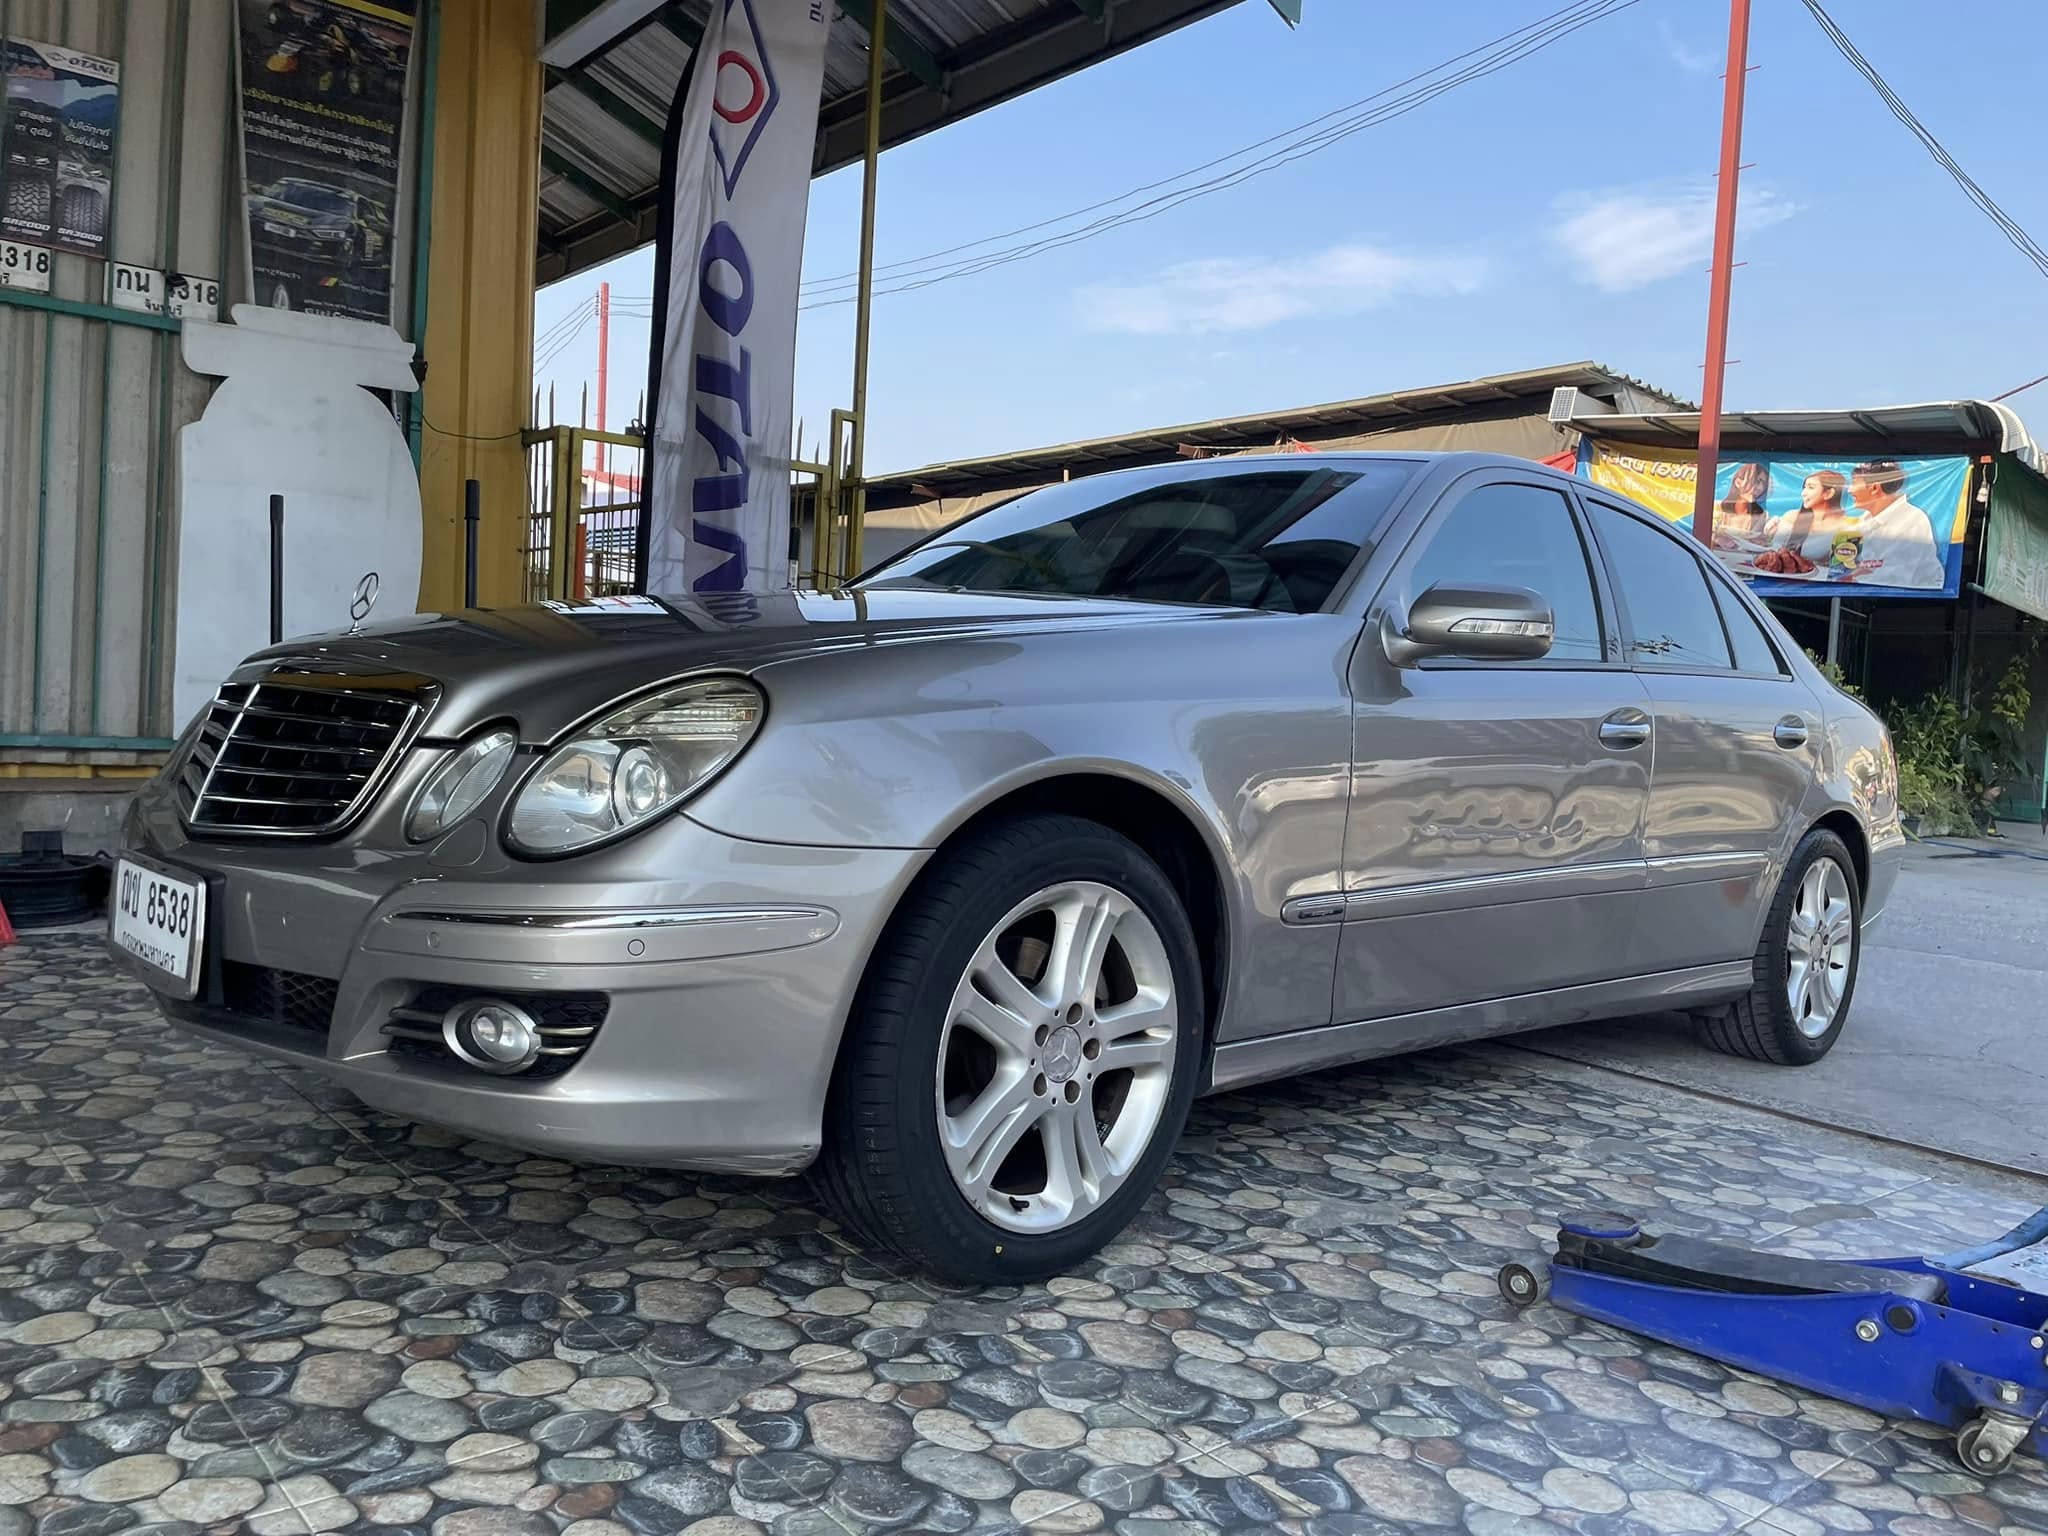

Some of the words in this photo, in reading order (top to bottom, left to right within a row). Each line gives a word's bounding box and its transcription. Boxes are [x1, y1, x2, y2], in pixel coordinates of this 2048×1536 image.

[69, 56, 116, 76] OTANI
[116, 268, 150, 293] กน
[147, 881, 190, 938] 8538
[123, 931, 176, 972] กรงเทพมหานคร
